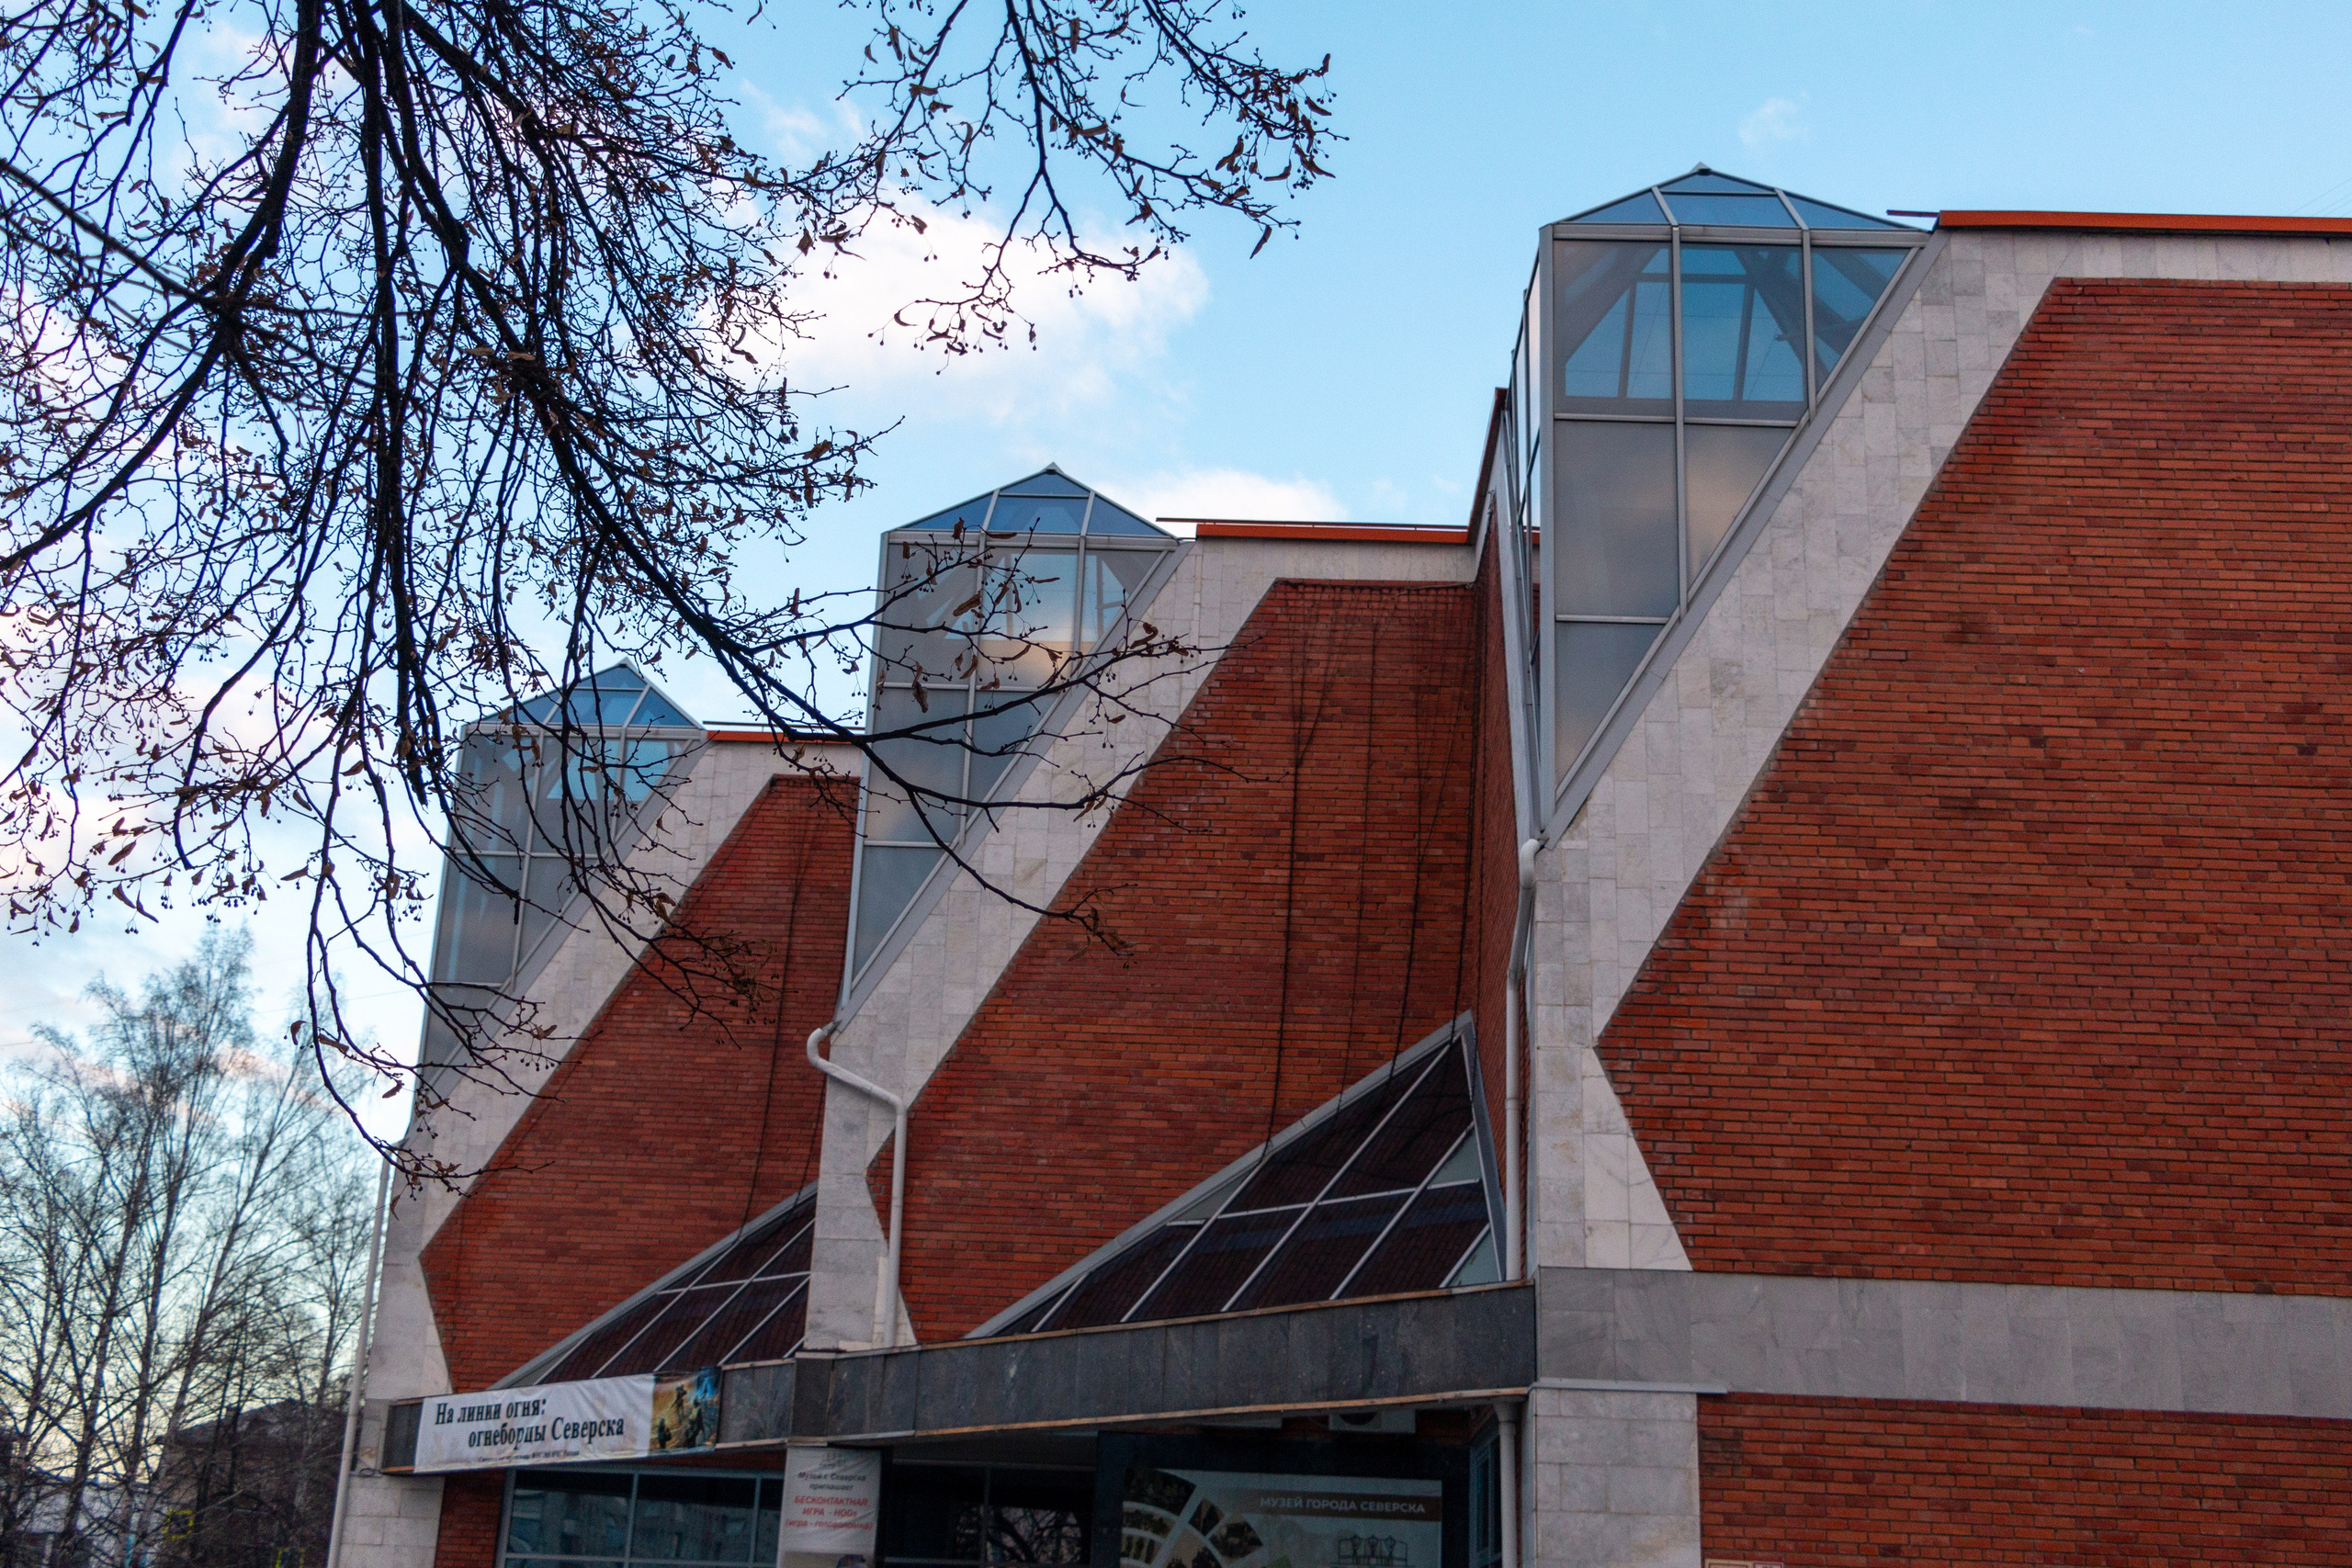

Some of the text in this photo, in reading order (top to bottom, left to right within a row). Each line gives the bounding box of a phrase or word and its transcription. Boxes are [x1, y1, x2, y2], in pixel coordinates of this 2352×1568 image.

[435, 1398, 547, 1425] На линии огня:
[468, 1416, 625, 1450] огнеборцы Северска
[794, 1495, 869, 1506] БЕСКОНТАКТНАЯ
[1260, 1496, 1426, 1514] МУЗЕЙ ГОРОДА СЕВЕРСКА
[802, 1507, 825, 1516] ИГРА
